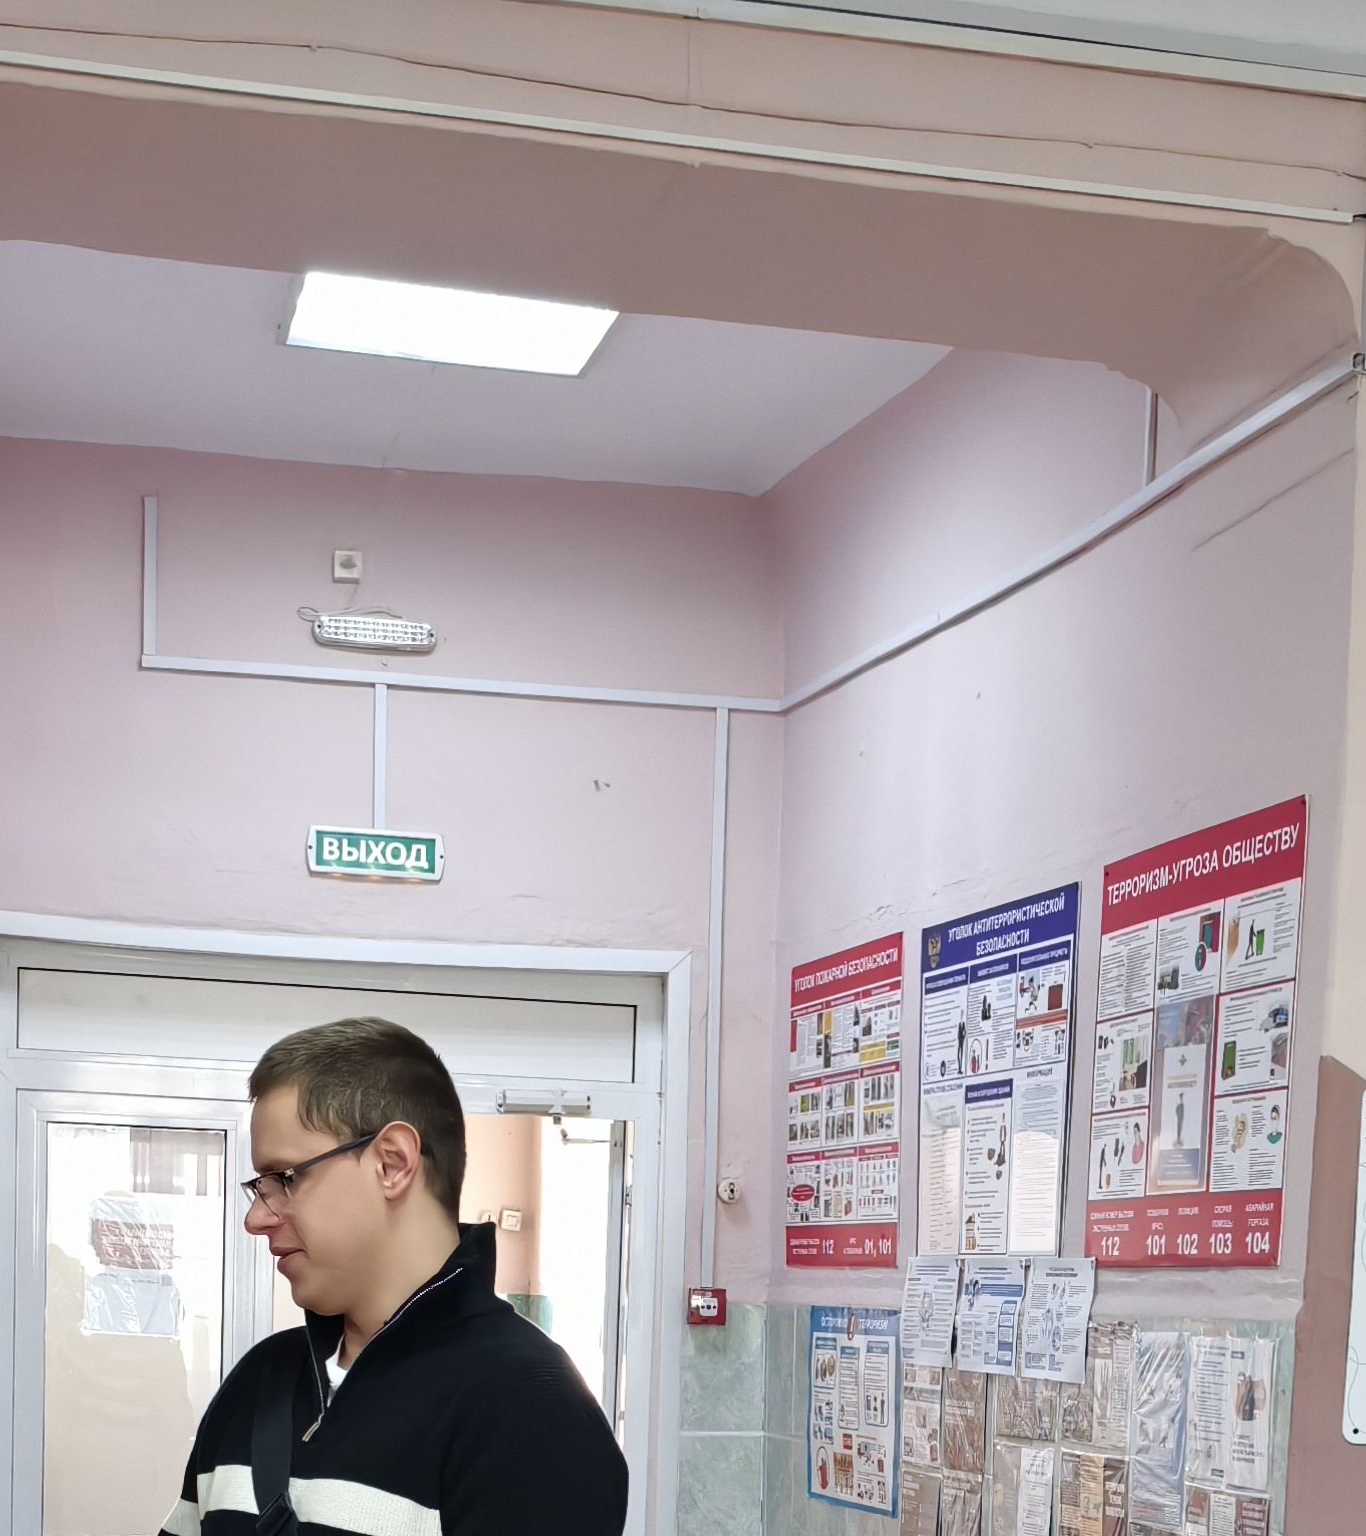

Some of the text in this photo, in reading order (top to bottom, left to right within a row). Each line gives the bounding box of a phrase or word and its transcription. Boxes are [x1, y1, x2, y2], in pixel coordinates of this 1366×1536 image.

[322, 837, 429, 869] ВЫХОД
[1108, 823, 1300, 906] ТЕРРОРИЗМ-УГРОЗА ОБЩЕСТВУ
[948, 892, 1066, 943] УГОЛОК АНТИТЕРРОРИСТИЧЕСКОЙ
[976, 928, 1030, 956] БЕЗОПАСНОСТИ
[878, 1237, 892, 1254] 101
[1101, 1236, 1120, 1256] 112
[1146, 1234, 1166, 1256] 101
[1176, 1234, 1198, 1255] 102
[1209, 1233, 1232, 1254] 103
[1245, 1232, 1270, 1254] 104
